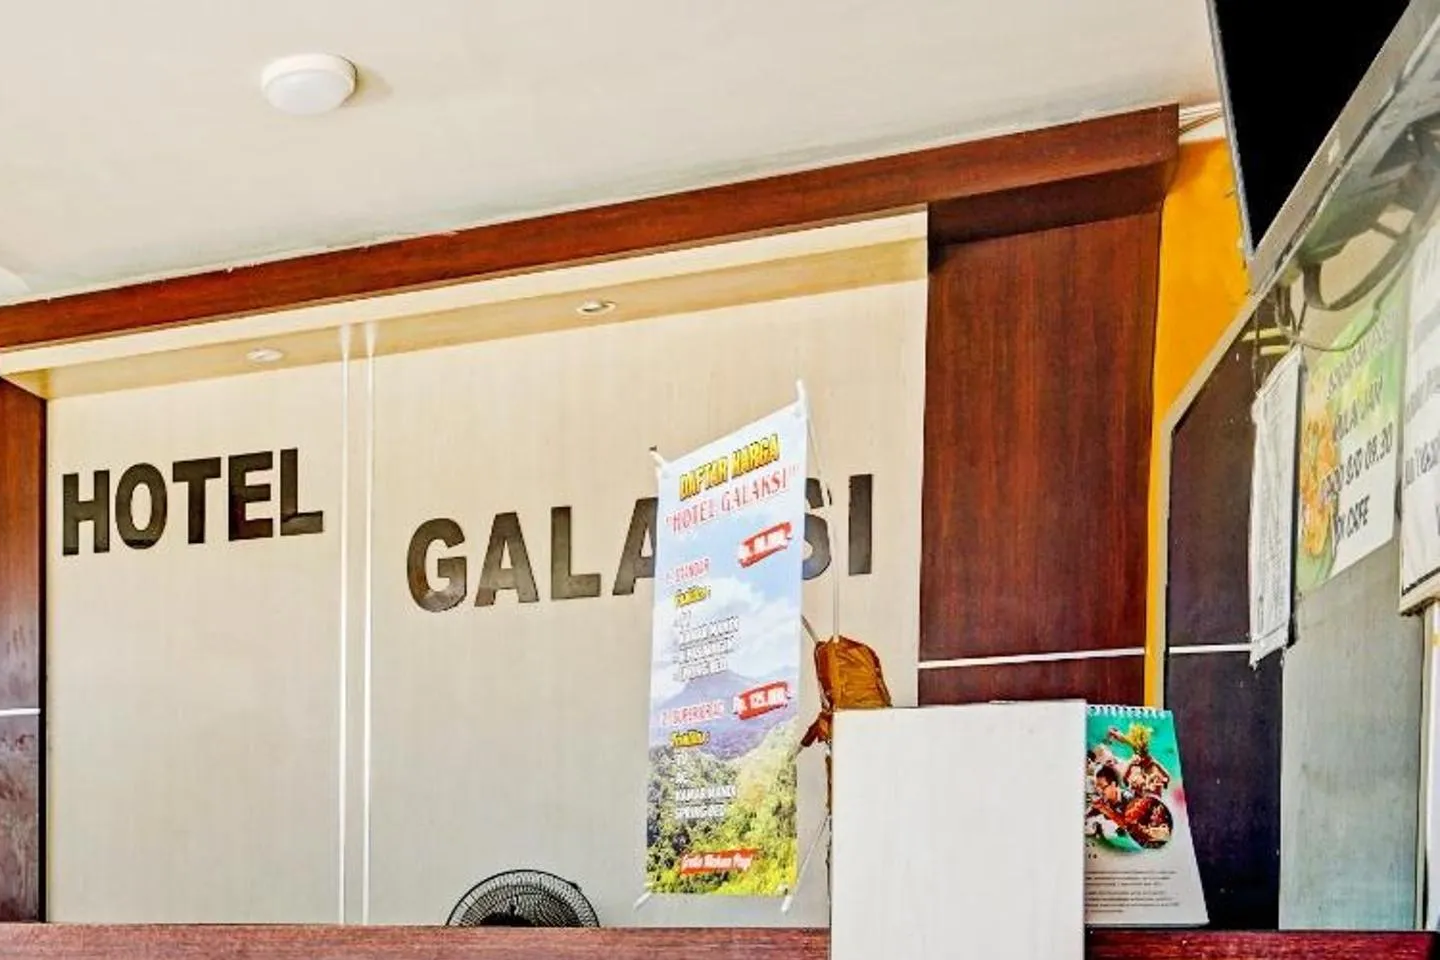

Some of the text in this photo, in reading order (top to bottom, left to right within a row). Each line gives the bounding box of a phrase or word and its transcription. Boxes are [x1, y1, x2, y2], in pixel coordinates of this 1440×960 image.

[679, 433, 779, 501] DAFTAR HARGA
[62, 447, 873, 613] HOTEL GALASI
